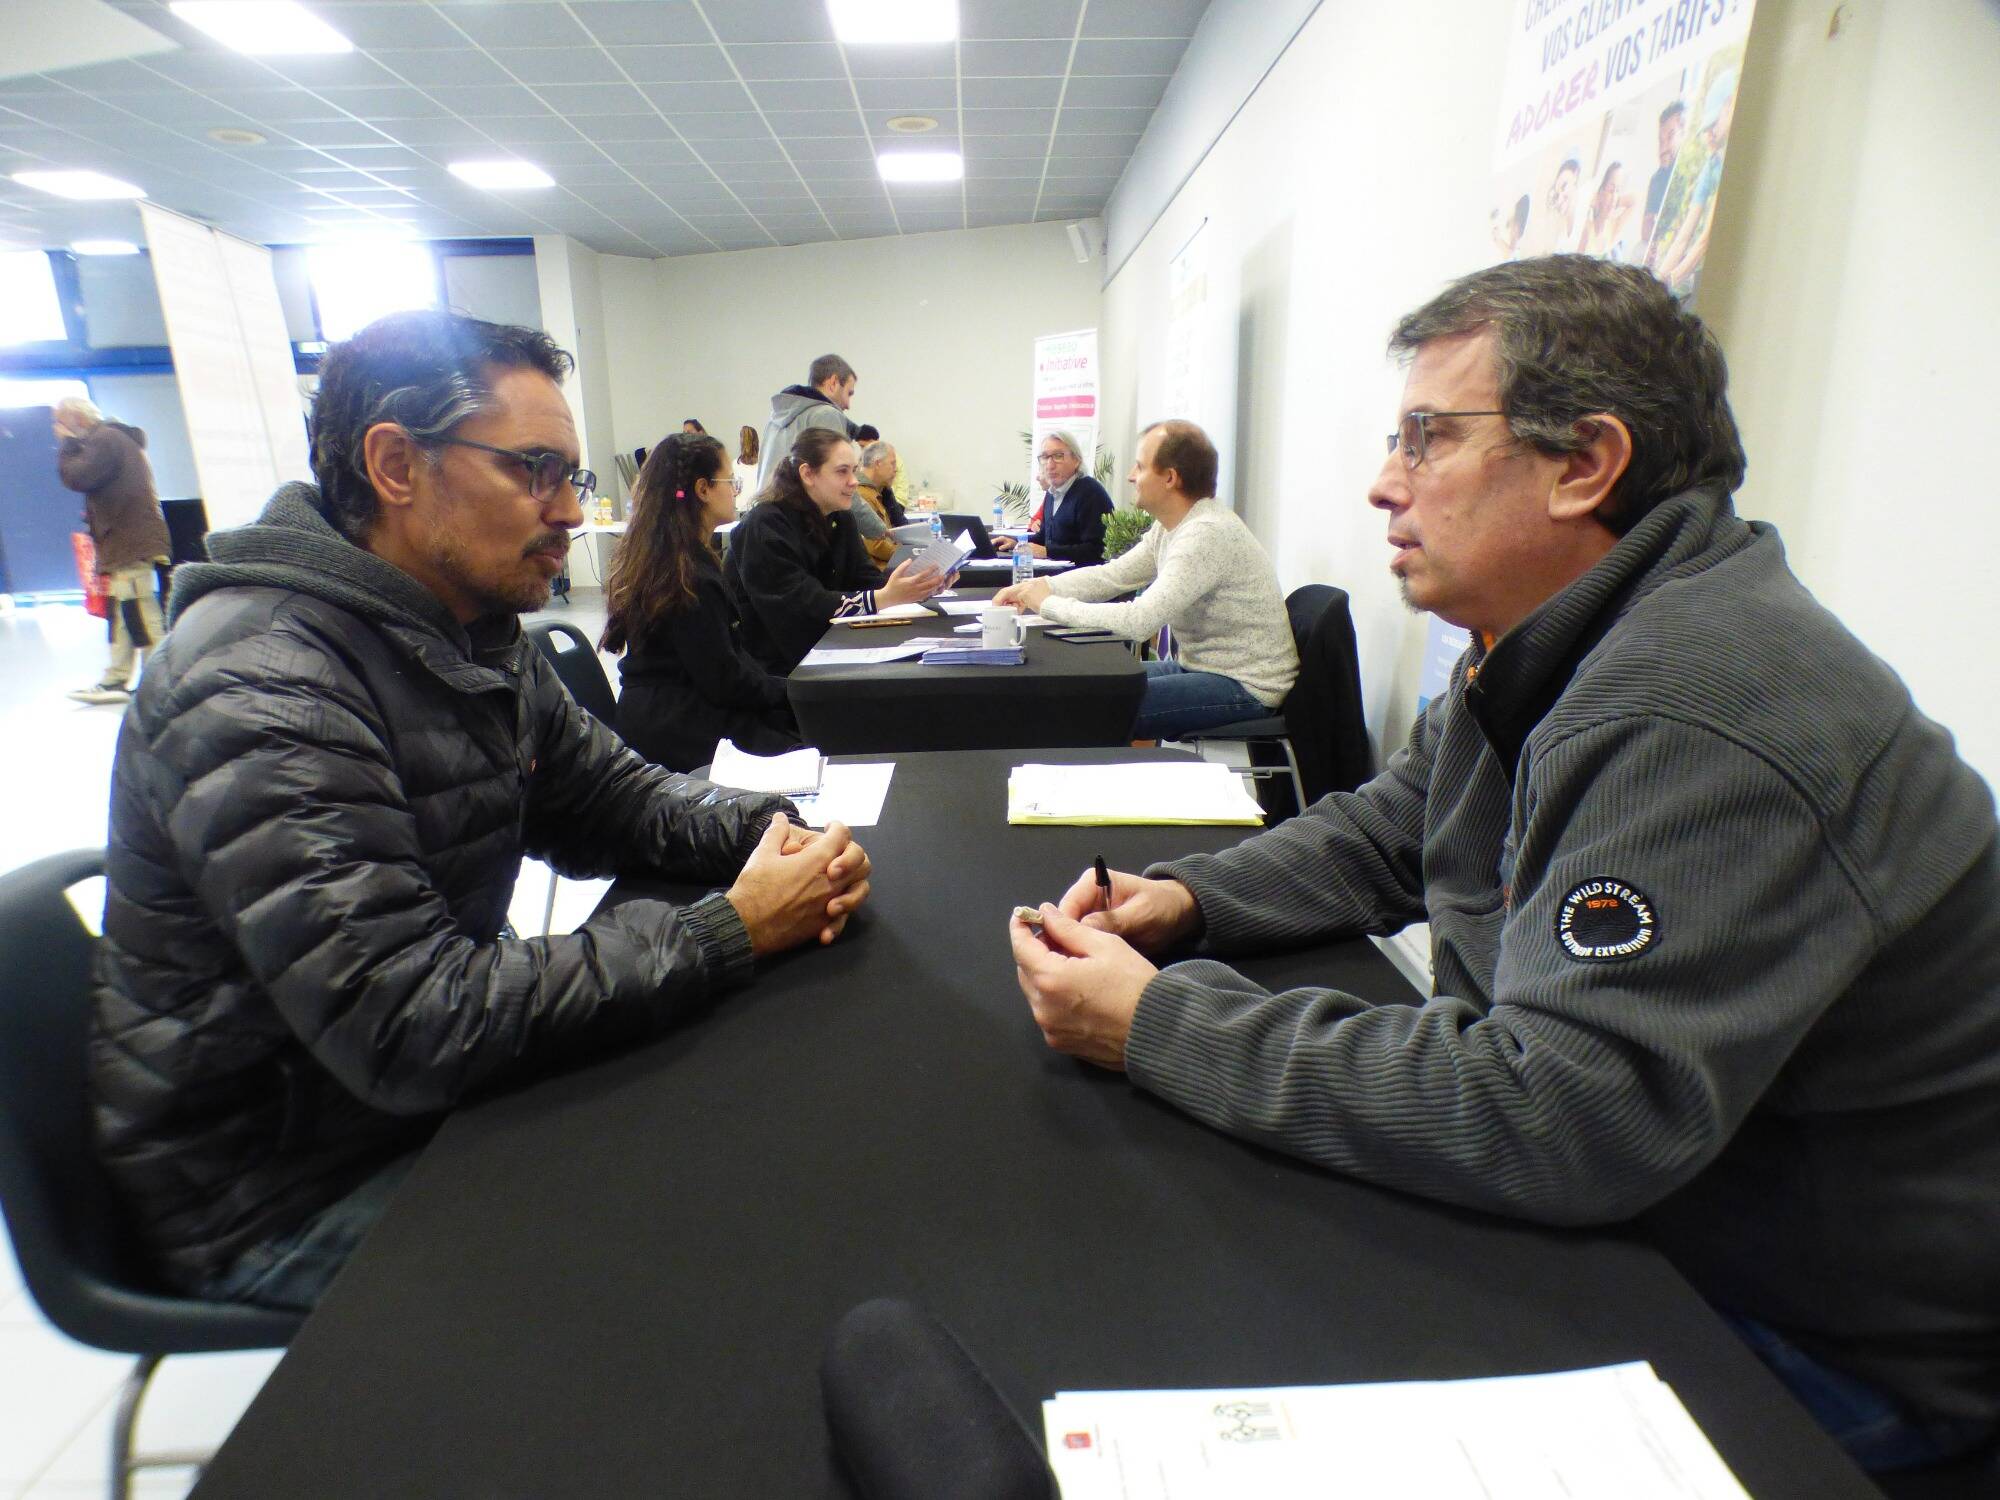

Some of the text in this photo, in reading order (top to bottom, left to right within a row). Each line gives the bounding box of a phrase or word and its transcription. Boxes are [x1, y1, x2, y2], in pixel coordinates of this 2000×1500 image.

[1541, 16, 1573, 73] VOS
[1505, 59, 1600, 149] ADORER
[1604, 26, 1645, 89] VOS
[1560, 905, 1576, 931] THE
